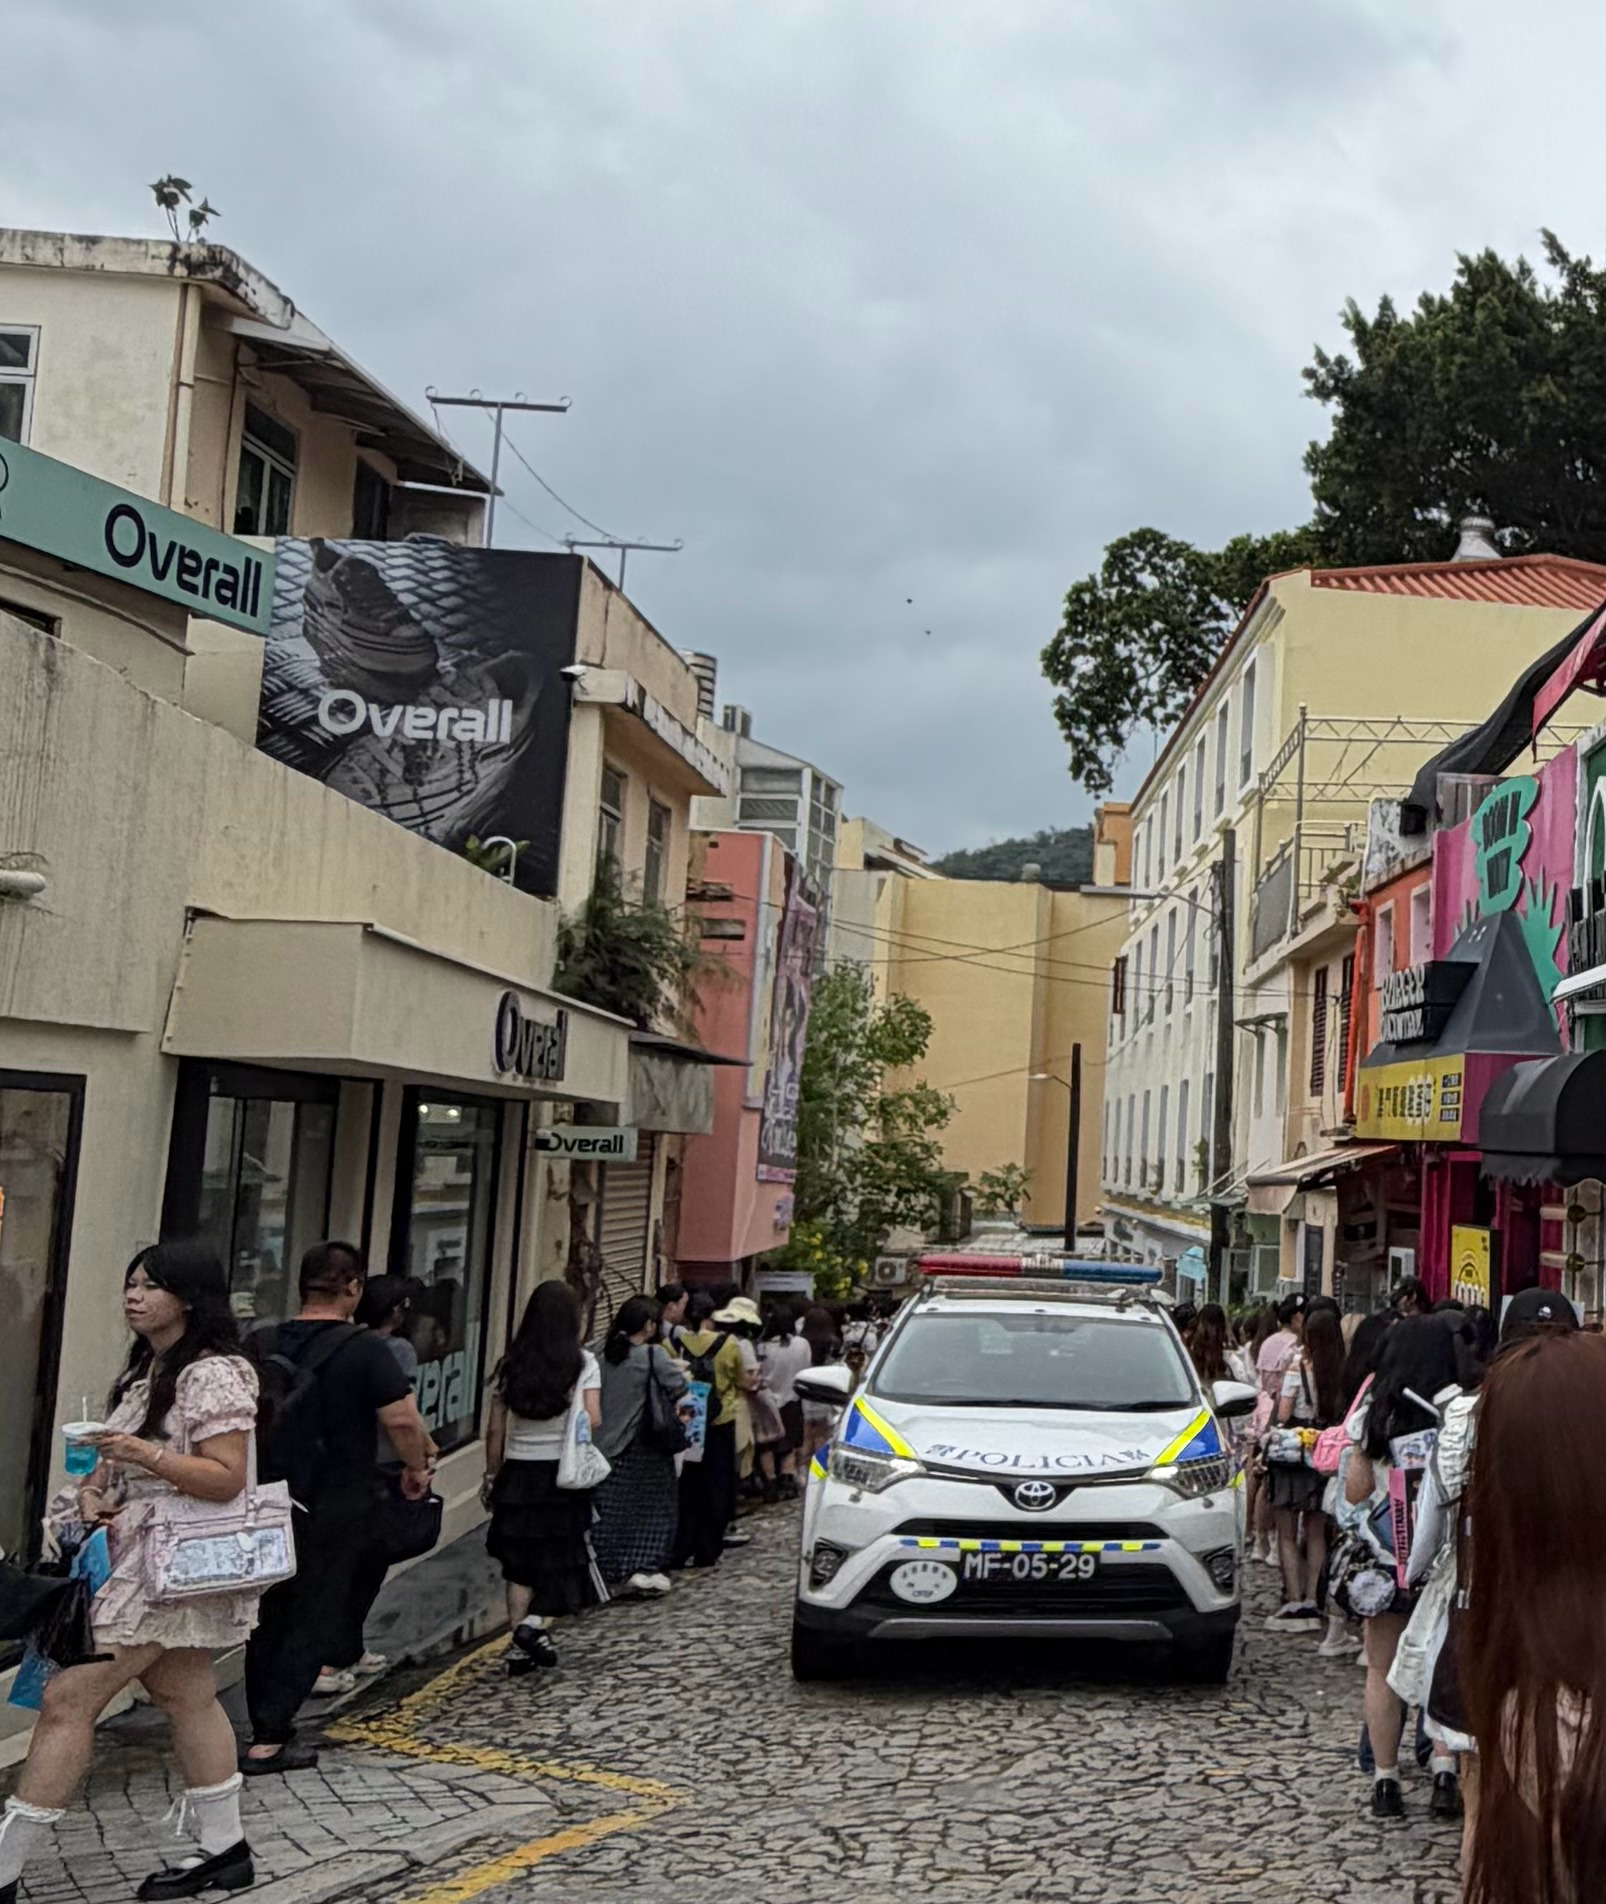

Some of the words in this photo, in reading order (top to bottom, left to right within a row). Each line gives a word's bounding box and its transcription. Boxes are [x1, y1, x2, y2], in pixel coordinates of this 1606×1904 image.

[104, 503, 262, 618] Overall
[317, 689, 514, 745] Overall
[963, 1553, 1096, 1580] MF-05-29
